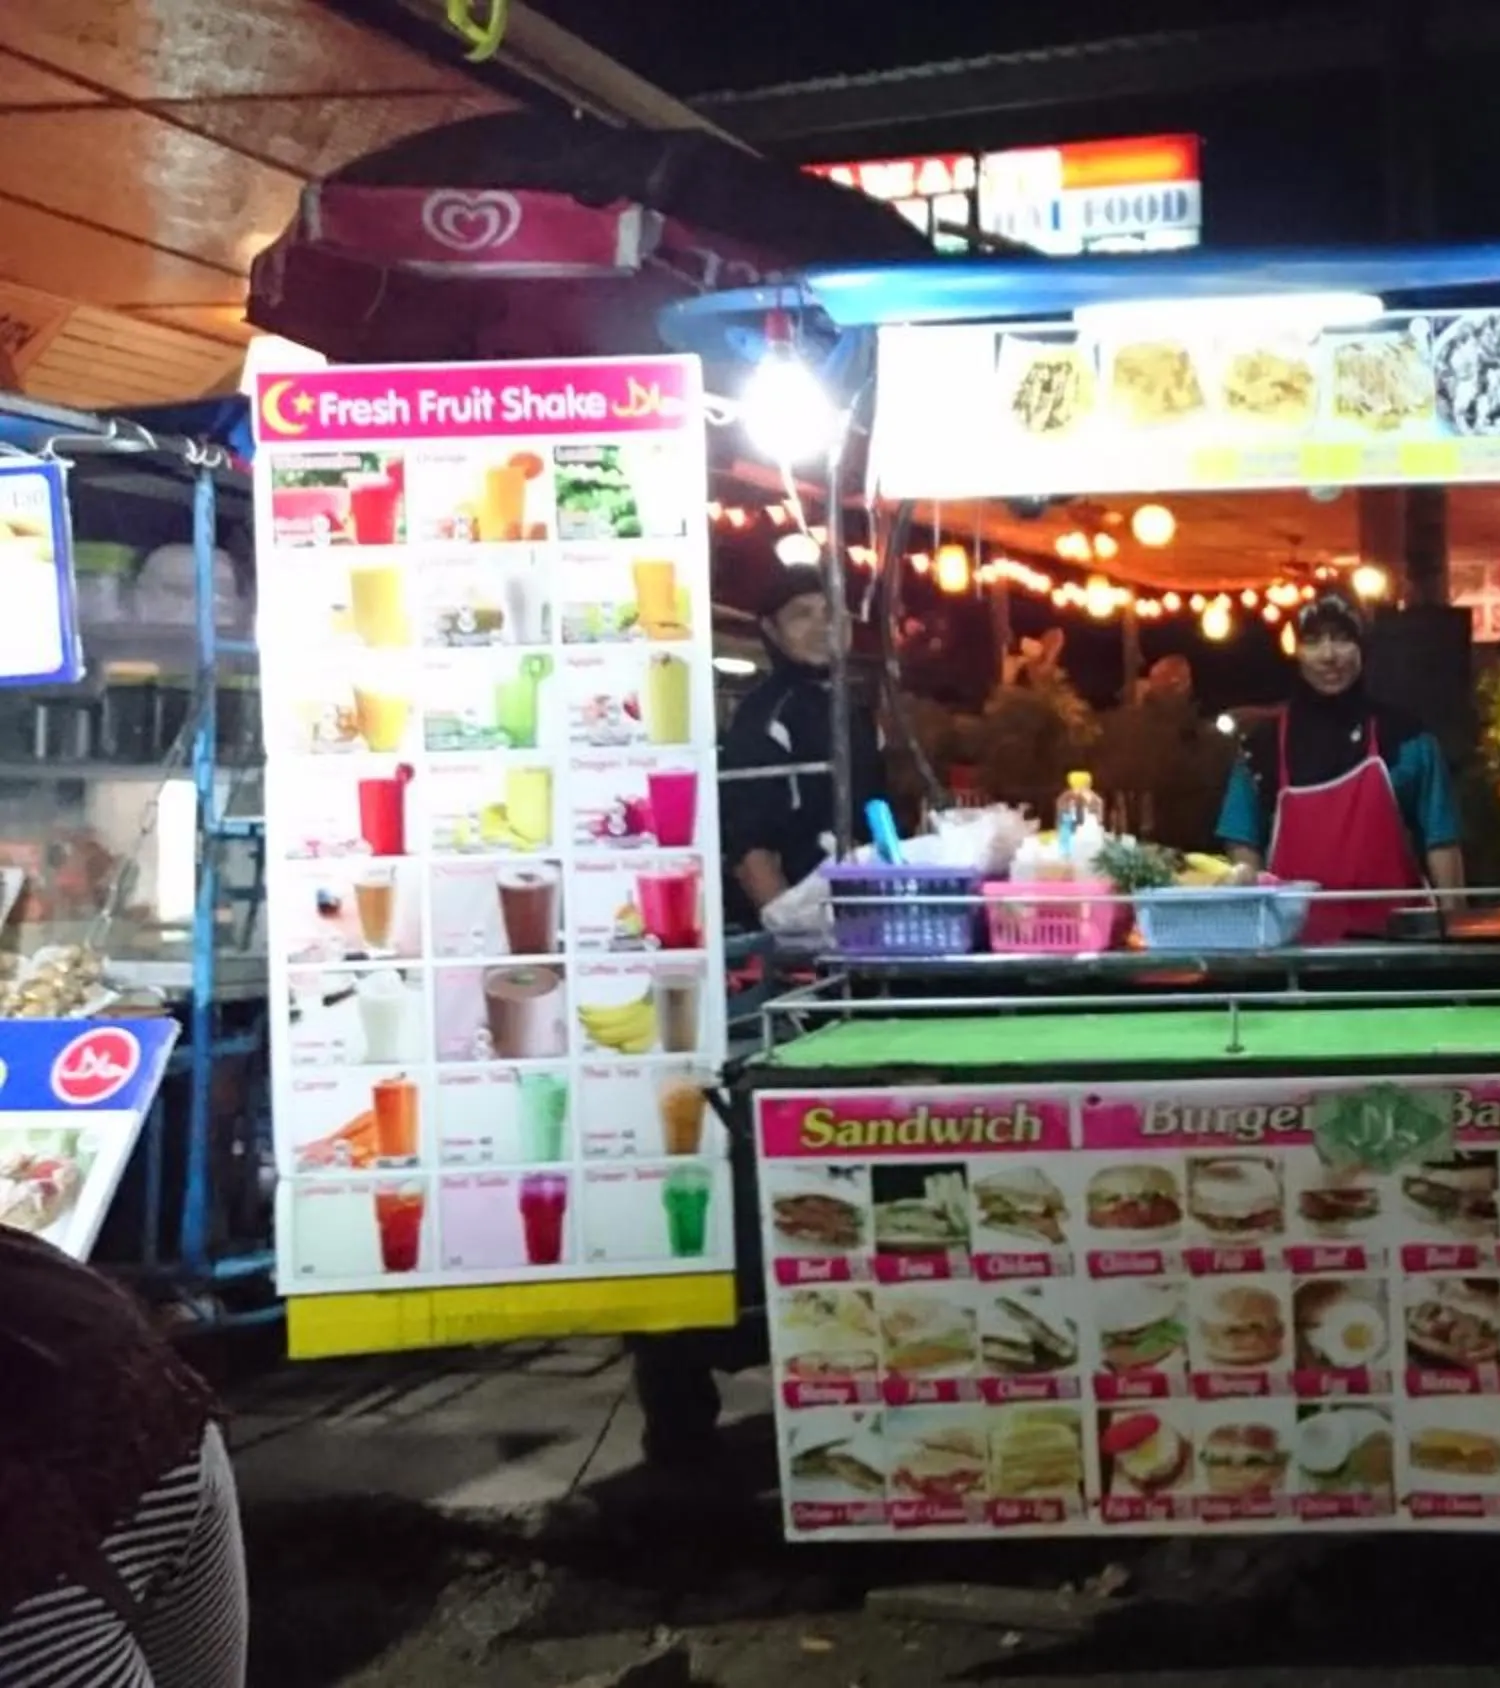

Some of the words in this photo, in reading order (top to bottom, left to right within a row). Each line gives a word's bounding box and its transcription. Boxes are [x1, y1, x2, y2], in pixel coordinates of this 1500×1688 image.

[318, 390, 410, 428] Fresh
[419, 387, 496, 424] Fruit
[500, 382, 608, 421] Shake
[801, 1102, 1043, 1149] Sandwich
